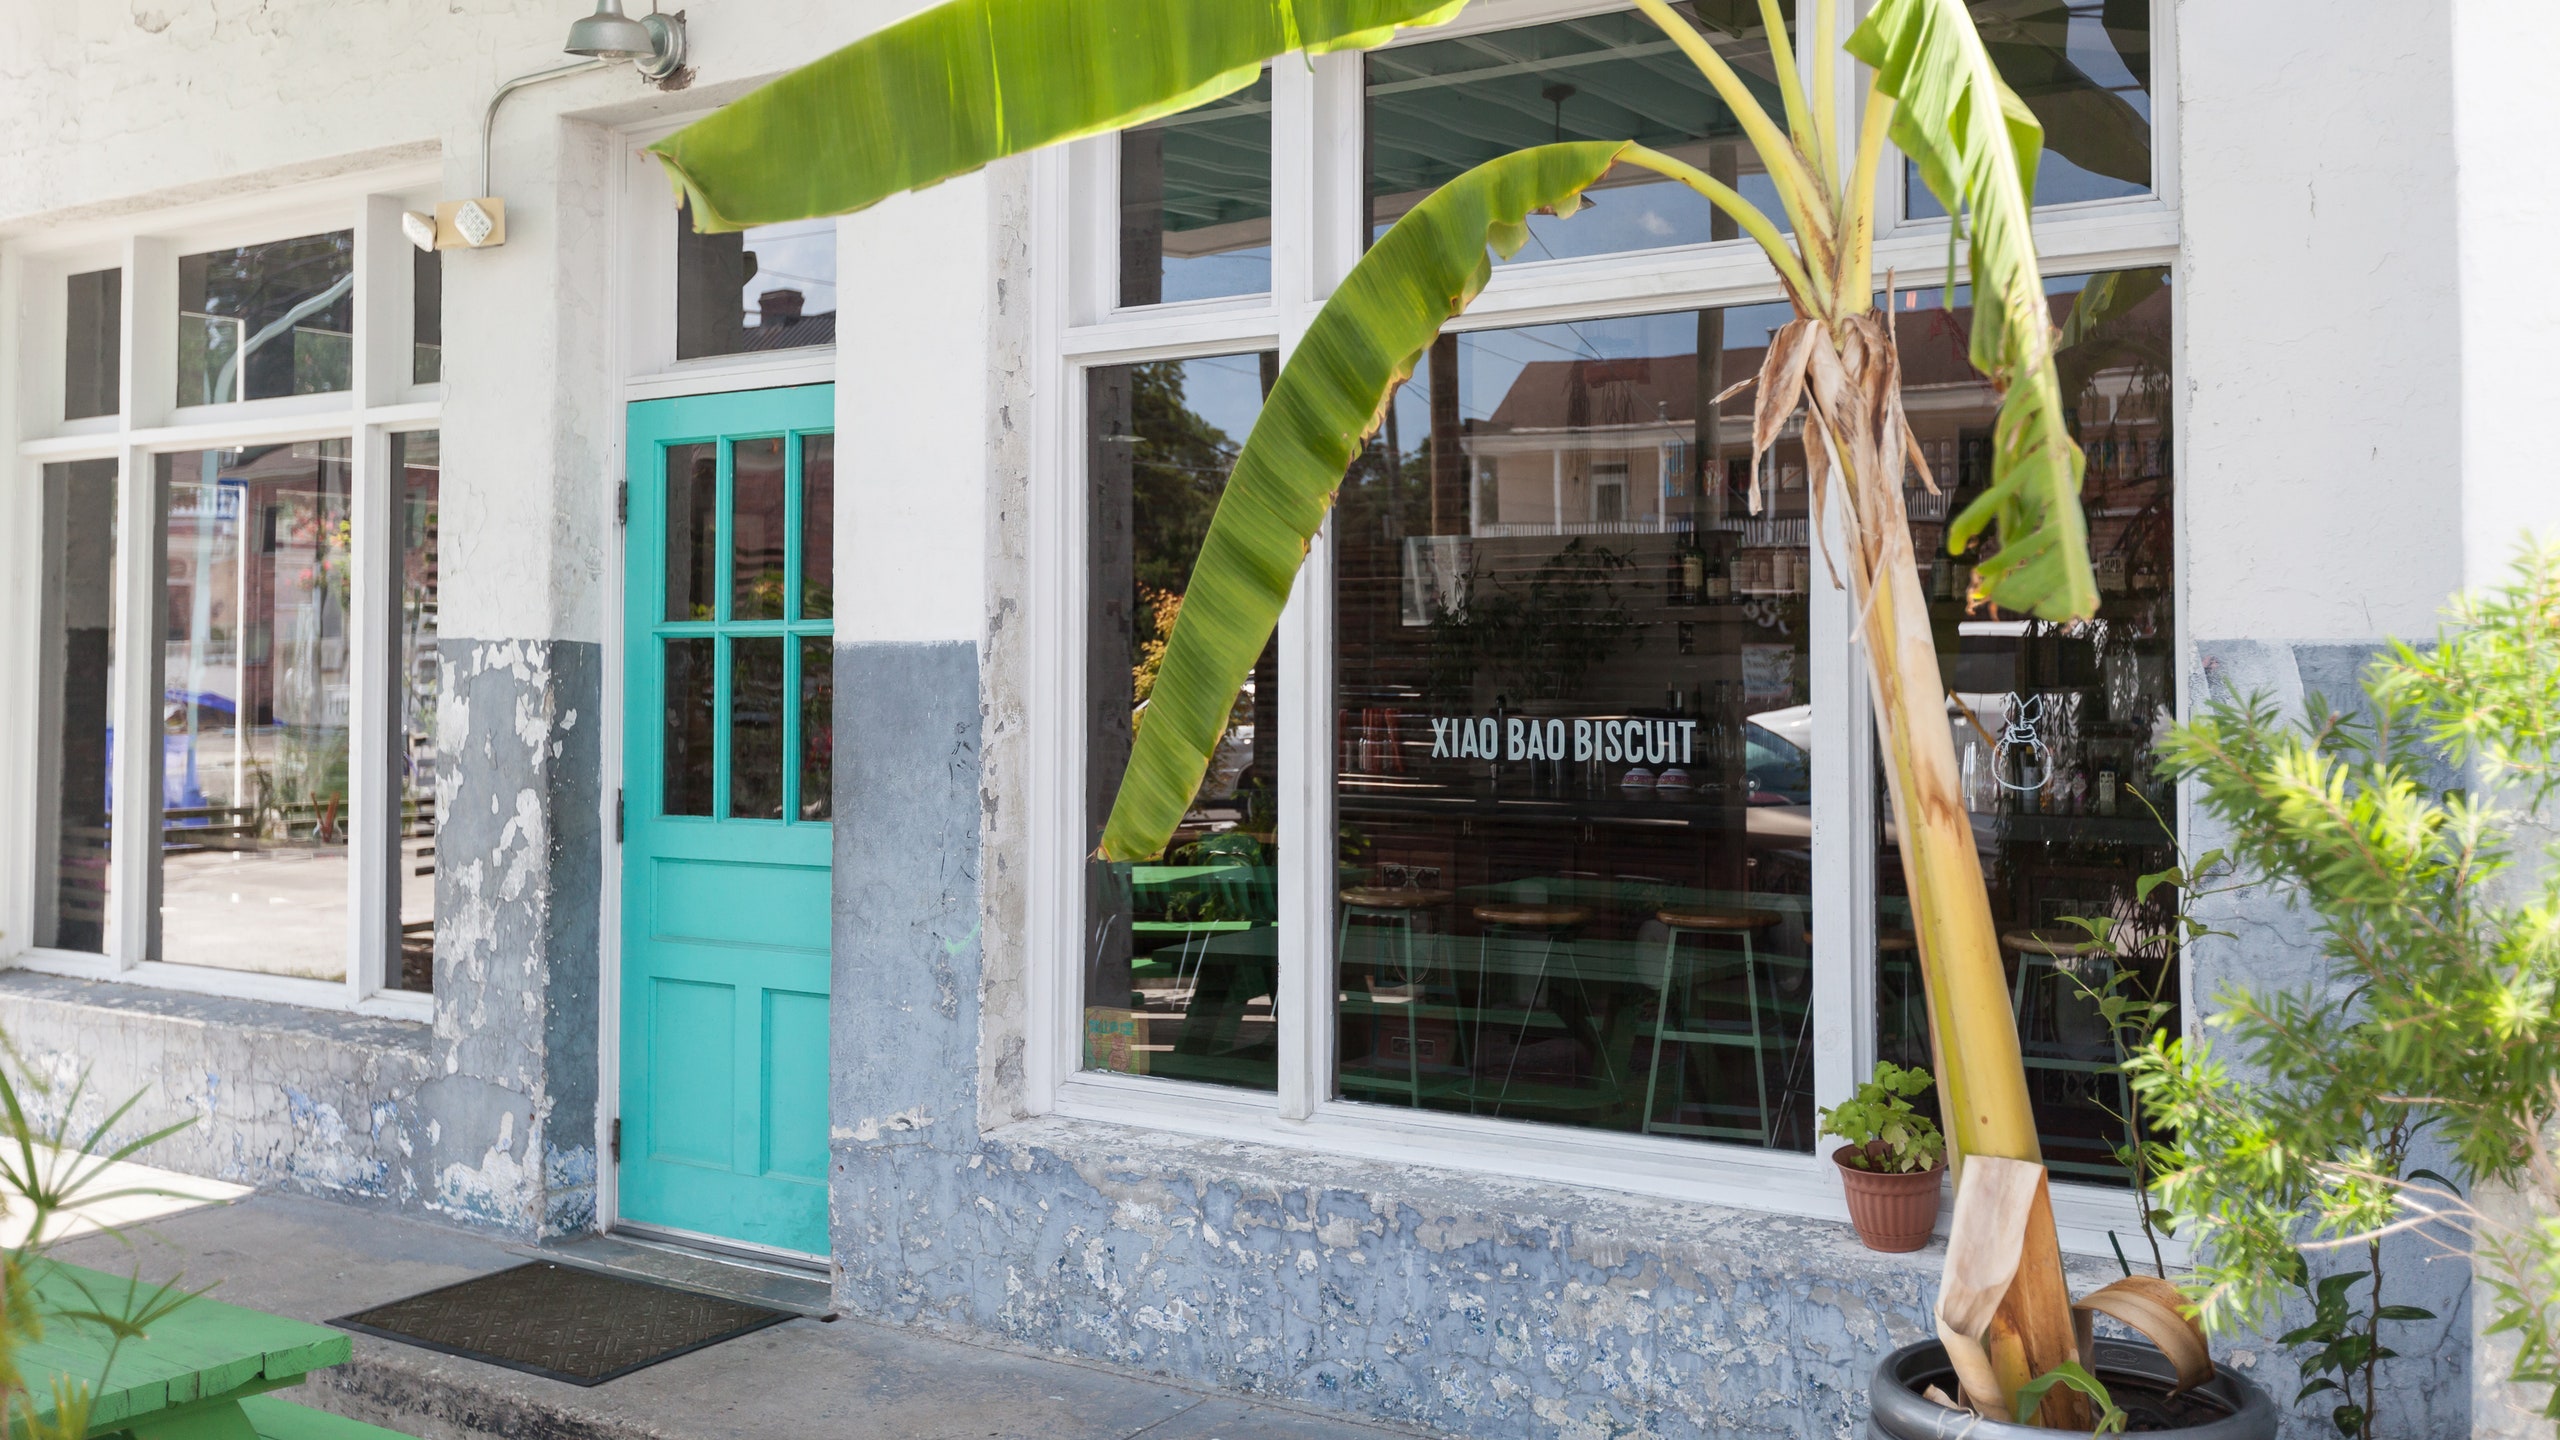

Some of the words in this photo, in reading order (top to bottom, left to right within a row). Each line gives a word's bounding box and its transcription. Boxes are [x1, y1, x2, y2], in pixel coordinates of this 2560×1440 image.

[1431, 717, 1498, 760] XIAO
[1507, 718, 1566, 761] BAO
[1574, 720, 1697, 764] BISCUIT
